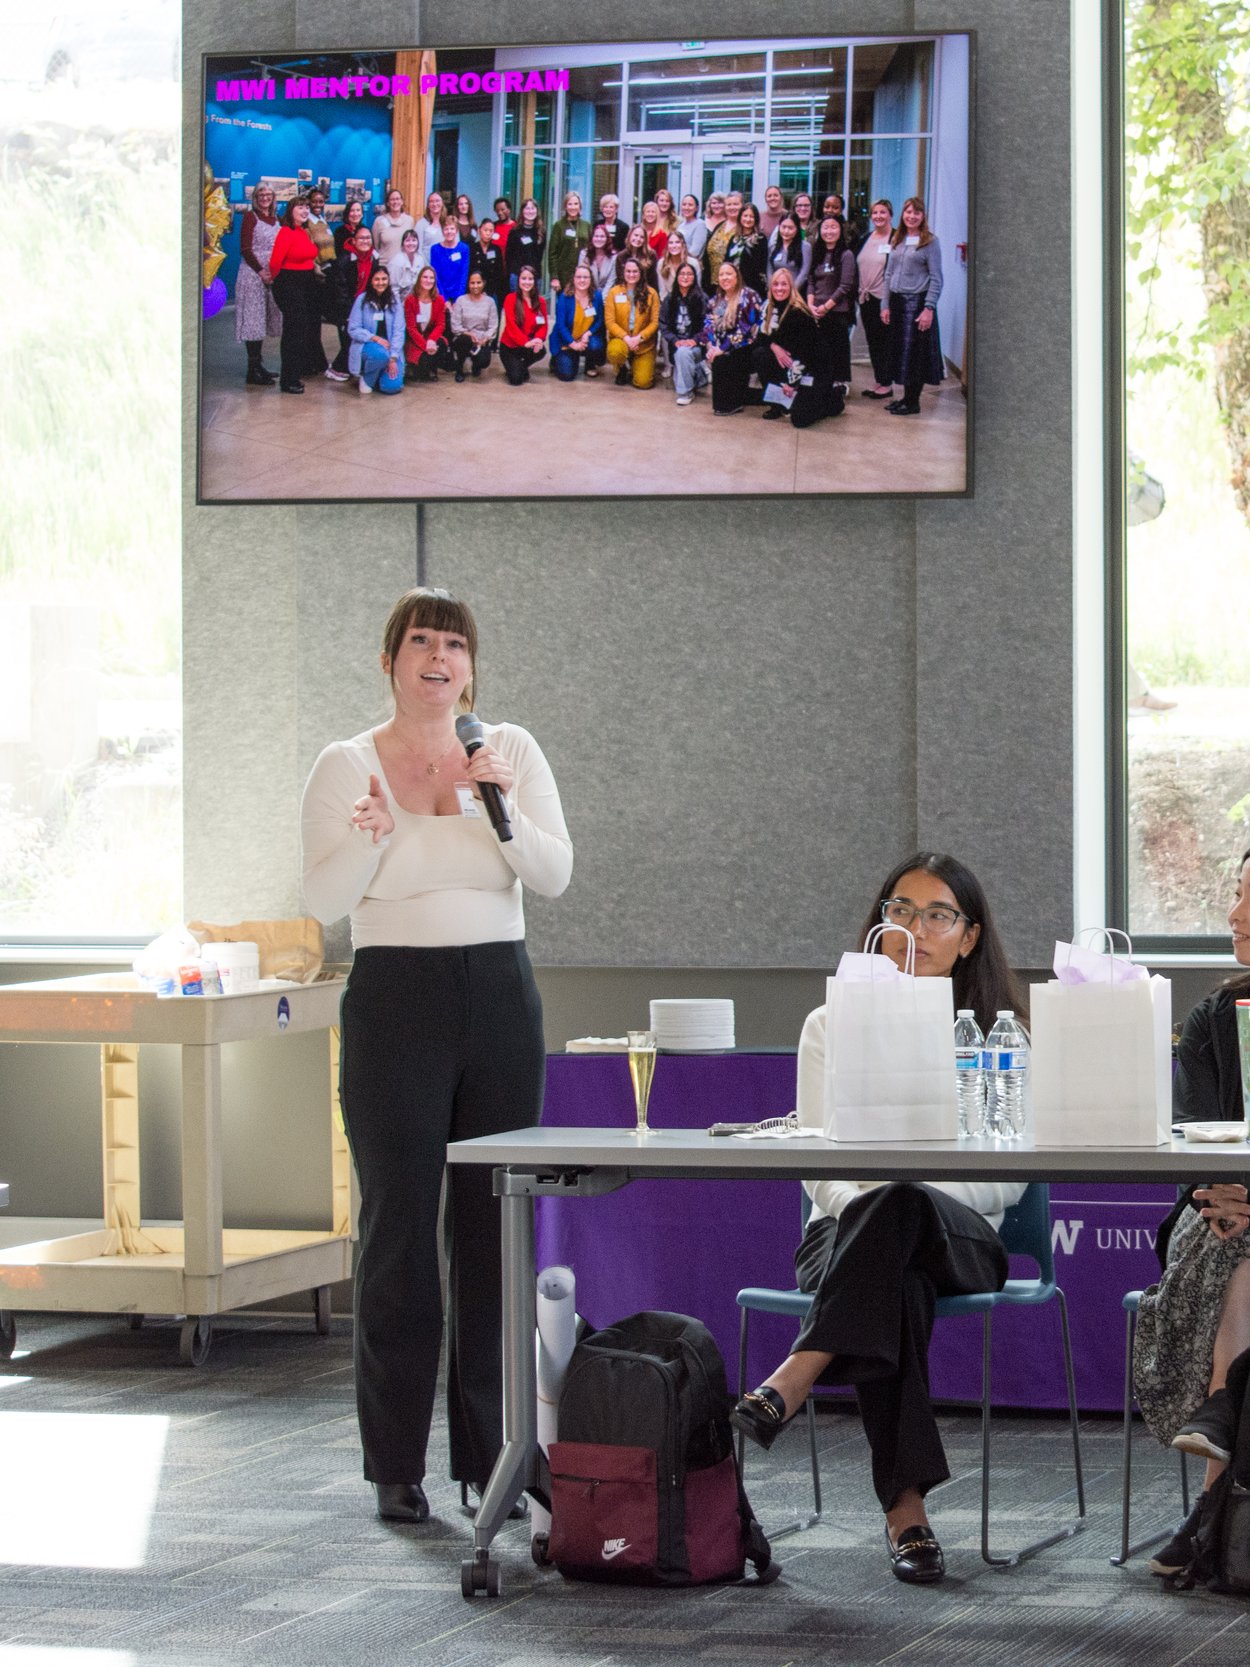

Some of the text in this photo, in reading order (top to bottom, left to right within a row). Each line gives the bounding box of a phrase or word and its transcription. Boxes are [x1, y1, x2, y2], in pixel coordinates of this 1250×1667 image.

[216, 69, 570, 101] MWI MENTOR PROGRAM
[210, 114, 232, 125] From
[233, 118, 245, 127] the
[603, 1537, 626, 1552] NIKE
